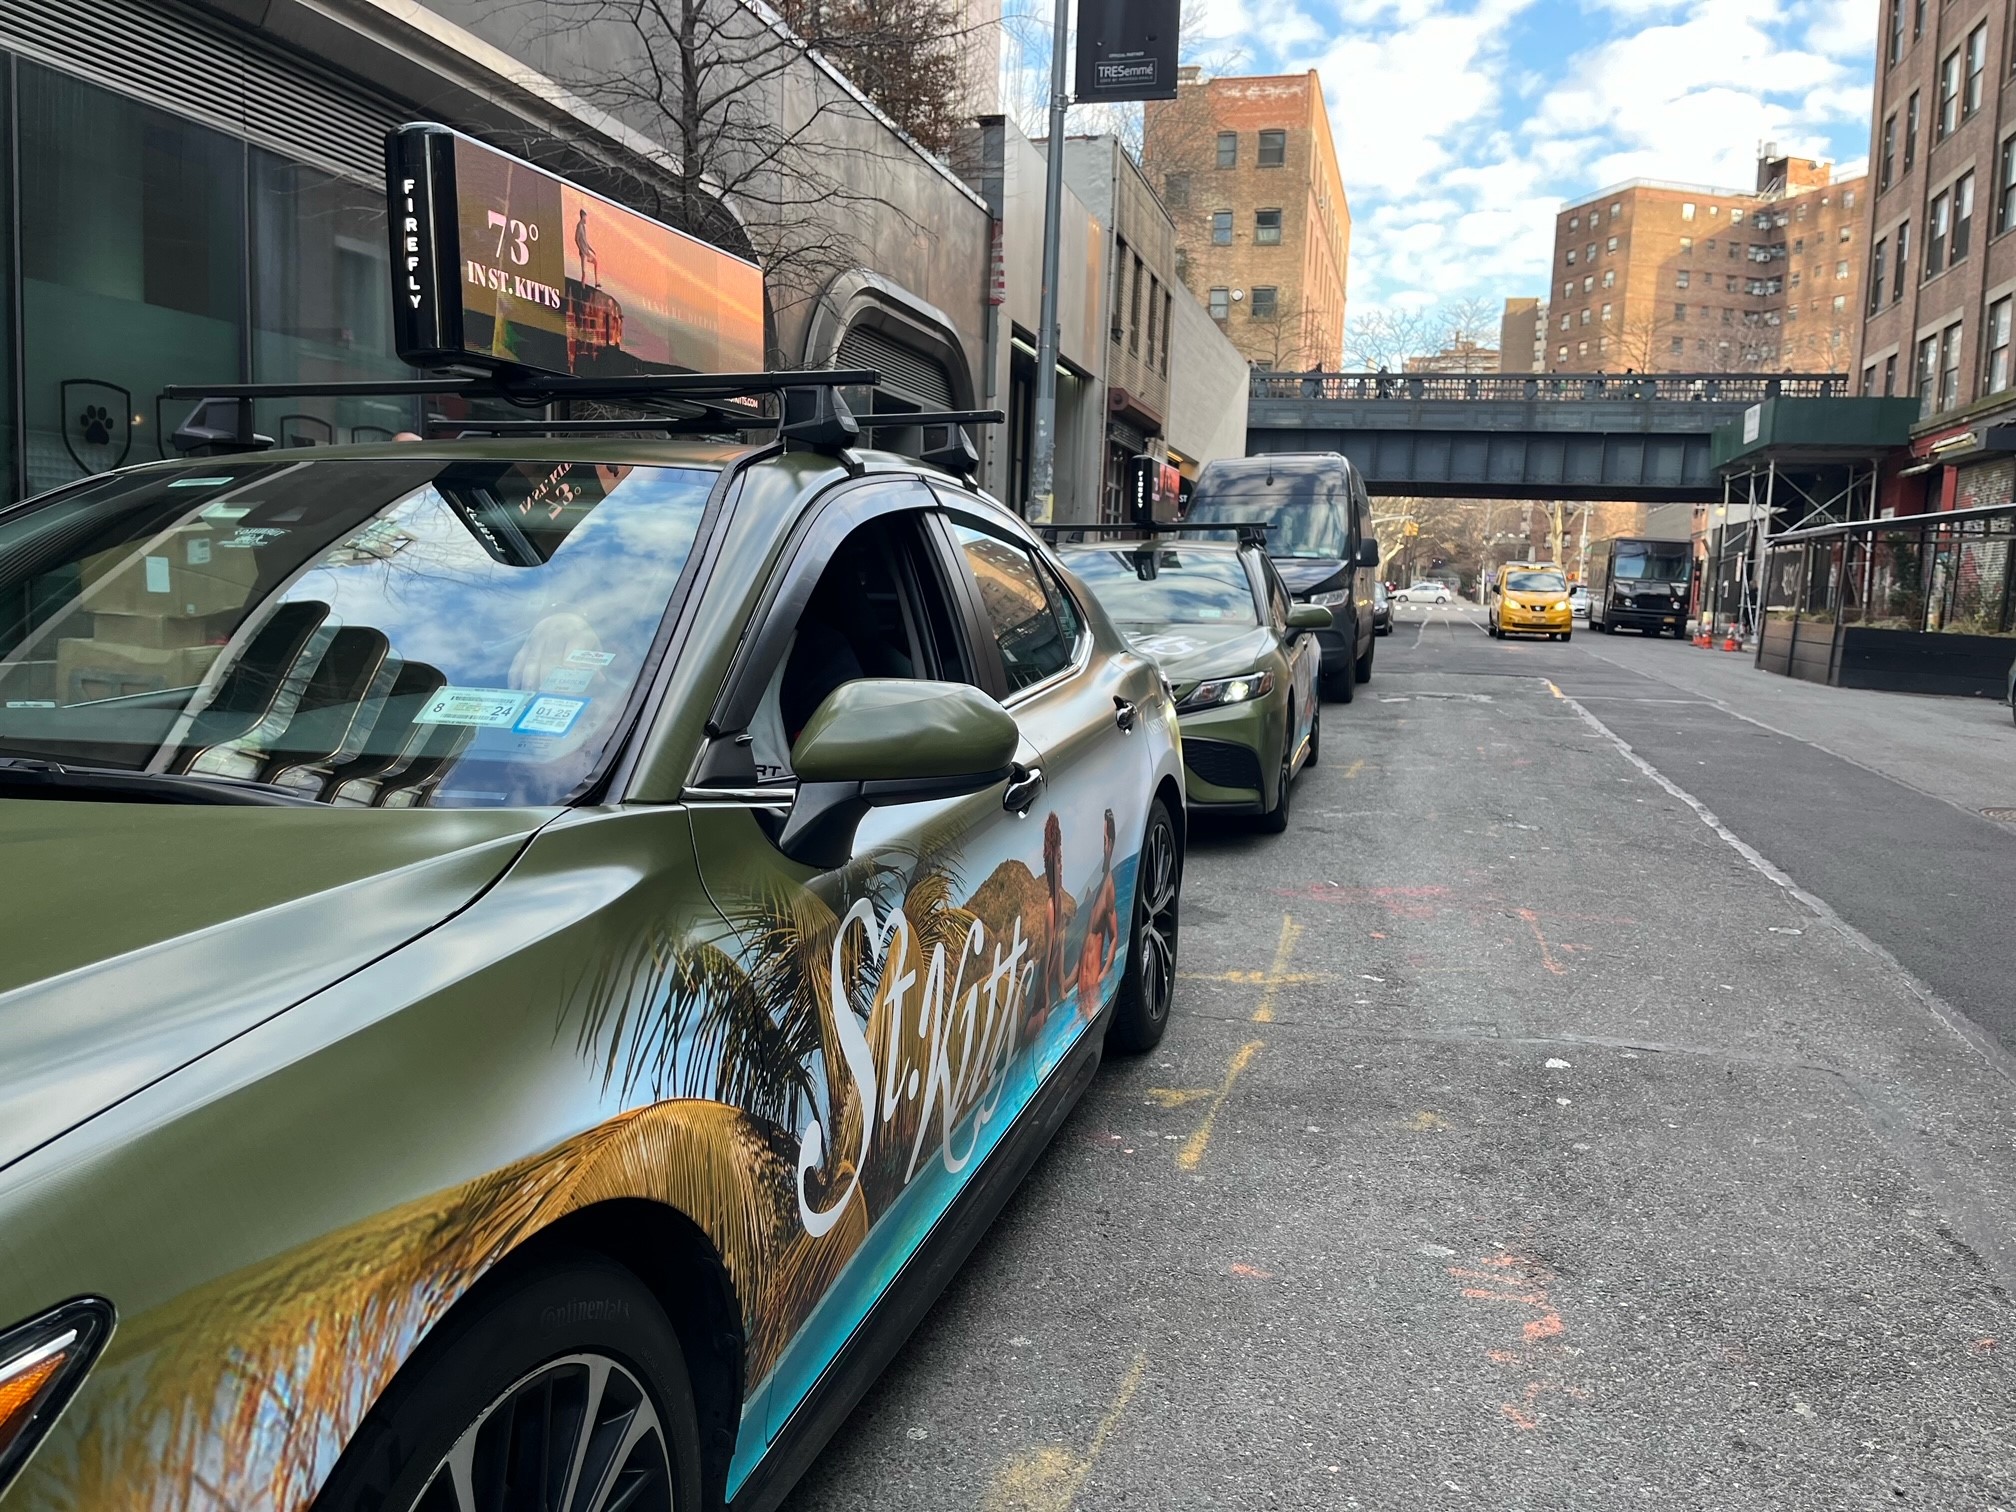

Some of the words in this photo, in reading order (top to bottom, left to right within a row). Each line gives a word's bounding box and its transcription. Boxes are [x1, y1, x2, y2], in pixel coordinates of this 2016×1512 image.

[1098, 63, 1154, 77] TRESemmé
[403, 178, 422, 309] FIREFLY
[467, 260, 487, 285] IN
[488, 267, 514, 295] ST.
[514, 276, 562, 310] KITTS
[432, 702, 446, 713] 8
[491, 705, 514, 718] 24
[904, 915, 1037, 1187] Kitts
